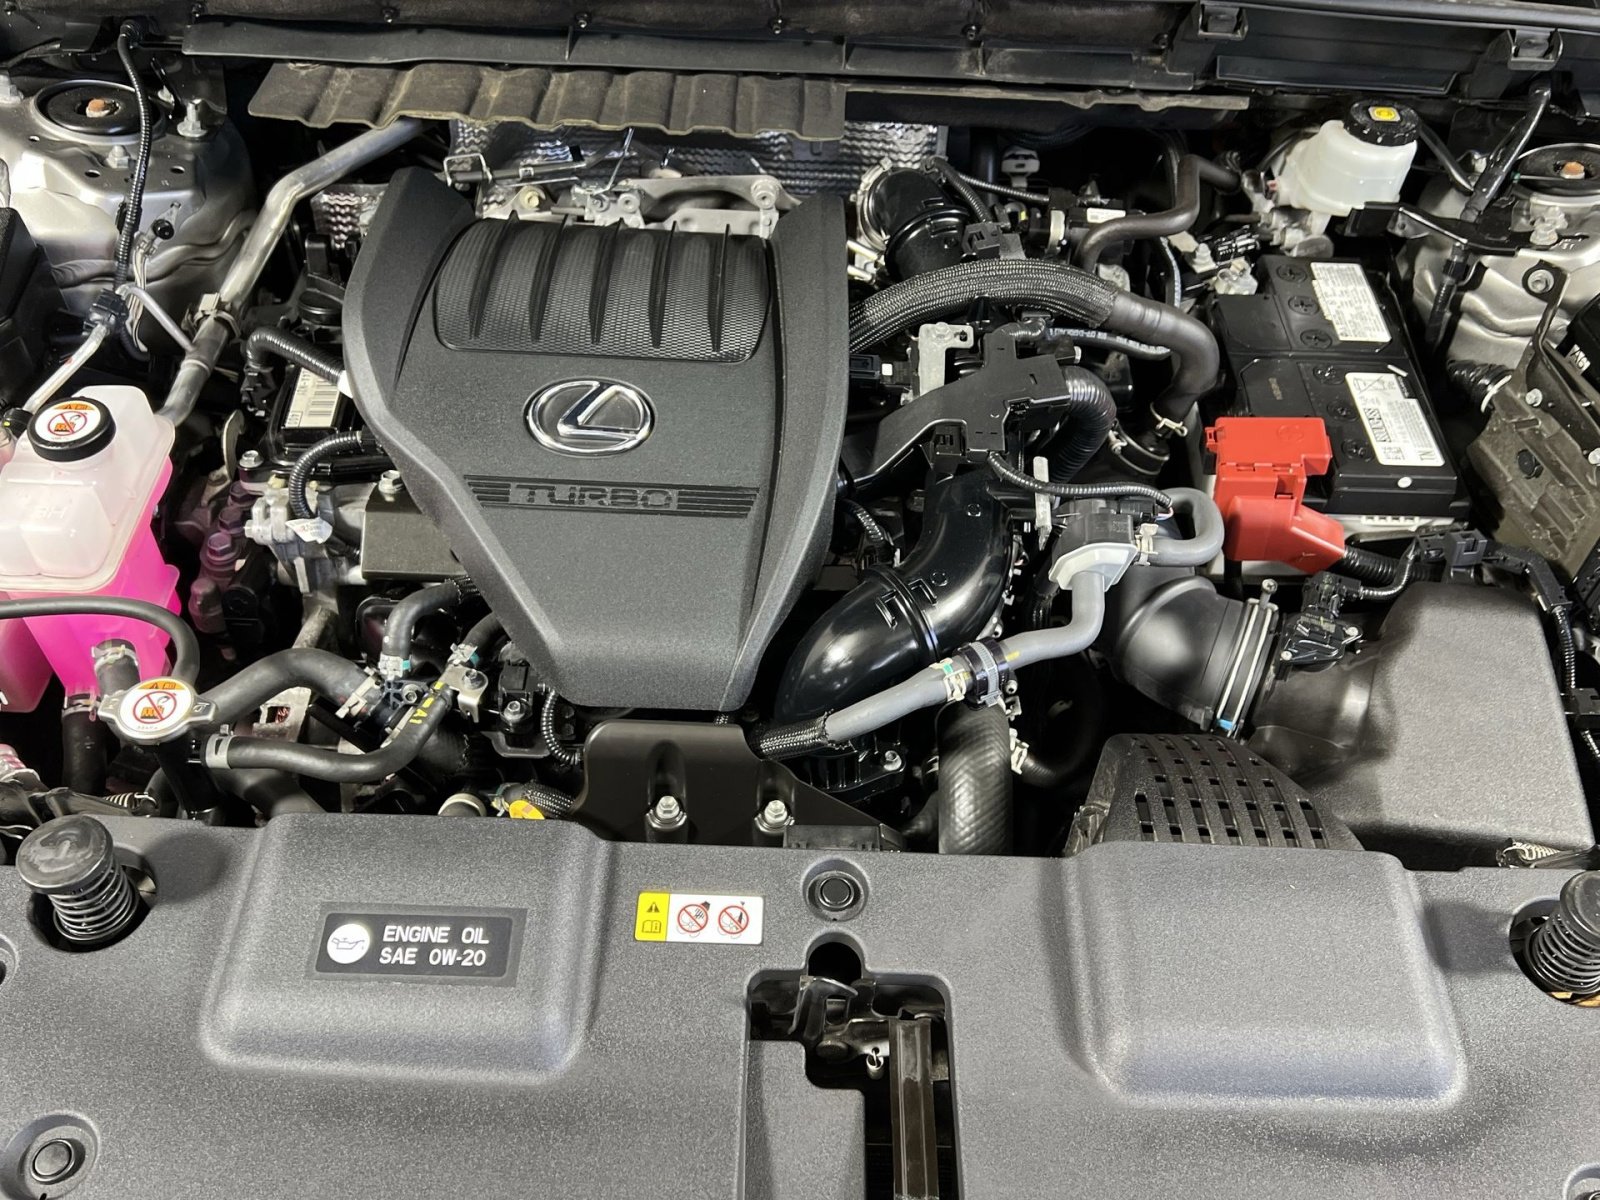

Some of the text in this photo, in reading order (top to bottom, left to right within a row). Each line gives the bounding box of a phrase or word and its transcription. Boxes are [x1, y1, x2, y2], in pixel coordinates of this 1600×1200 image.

[516, 484, 673, 508] TURBO
[383, 925, 490, 944] ENGINE OIL
[379, 947, 418, 965] SAE
